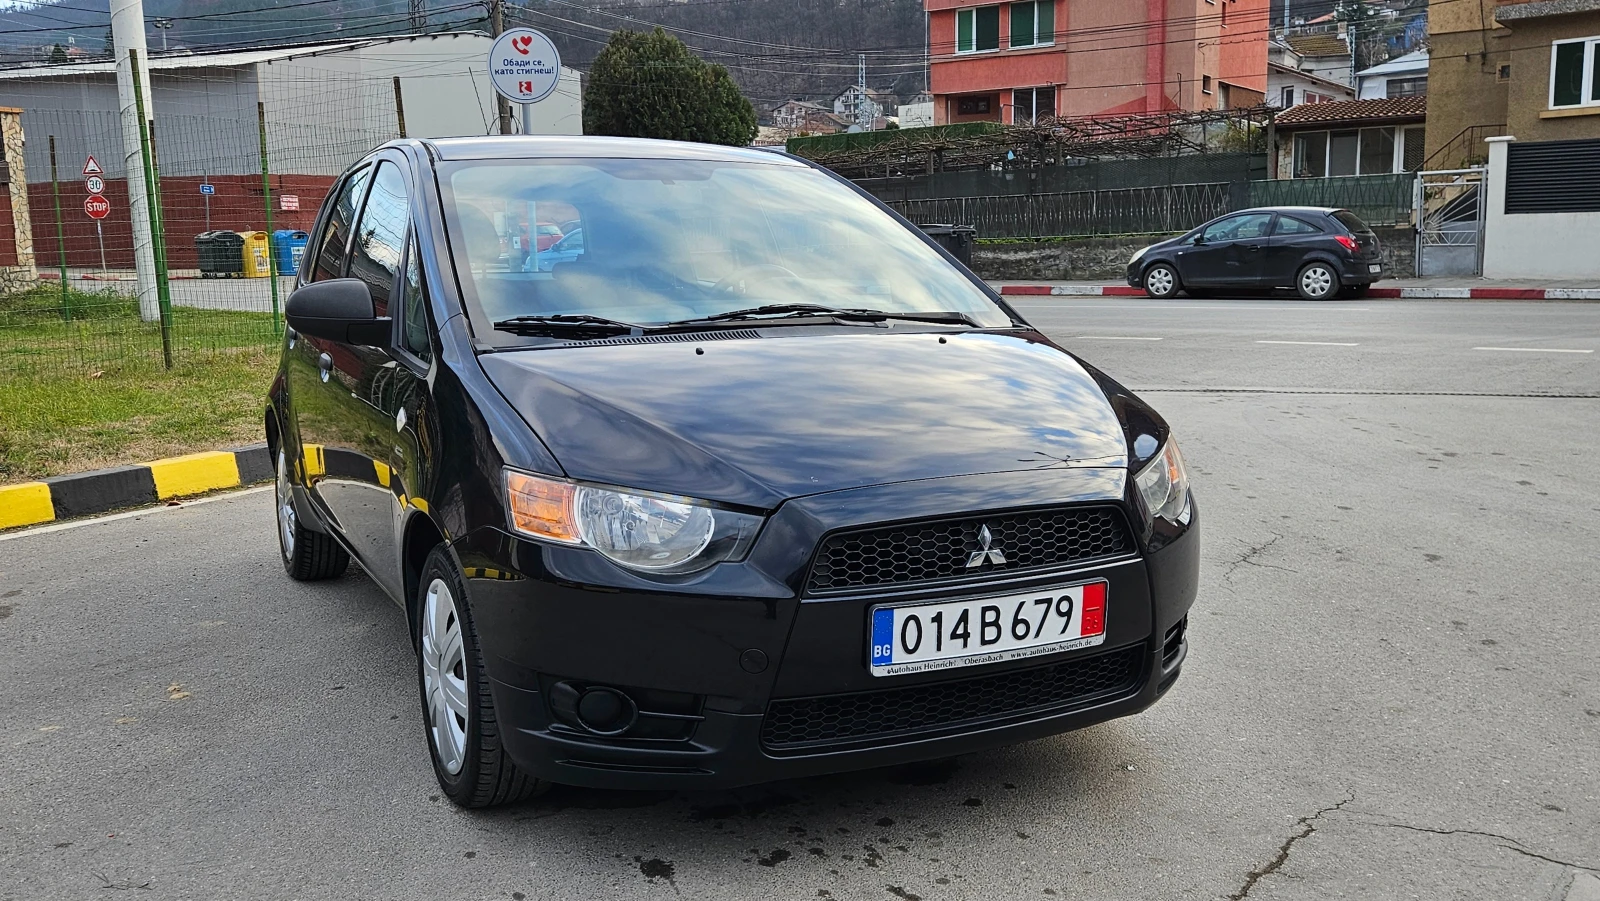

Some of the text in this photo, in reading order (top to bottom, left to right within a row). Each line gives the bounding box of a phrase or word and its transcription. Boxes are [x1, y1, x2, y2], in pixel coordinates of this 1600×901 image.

[503, 58, 531, 67] Обади
[516, 66, 554, 75] стигнеш!
[89, 180, 101, 190] 30
[87, 202, 107, 212] STOP
[874, 644, 891, 658] BG
[889, 663, 922, 674] Autohaus
[964, 653, 1004, 665] Oberasbach
[1010, 639, 1093, 659] www.autohaus-heinrich.de
